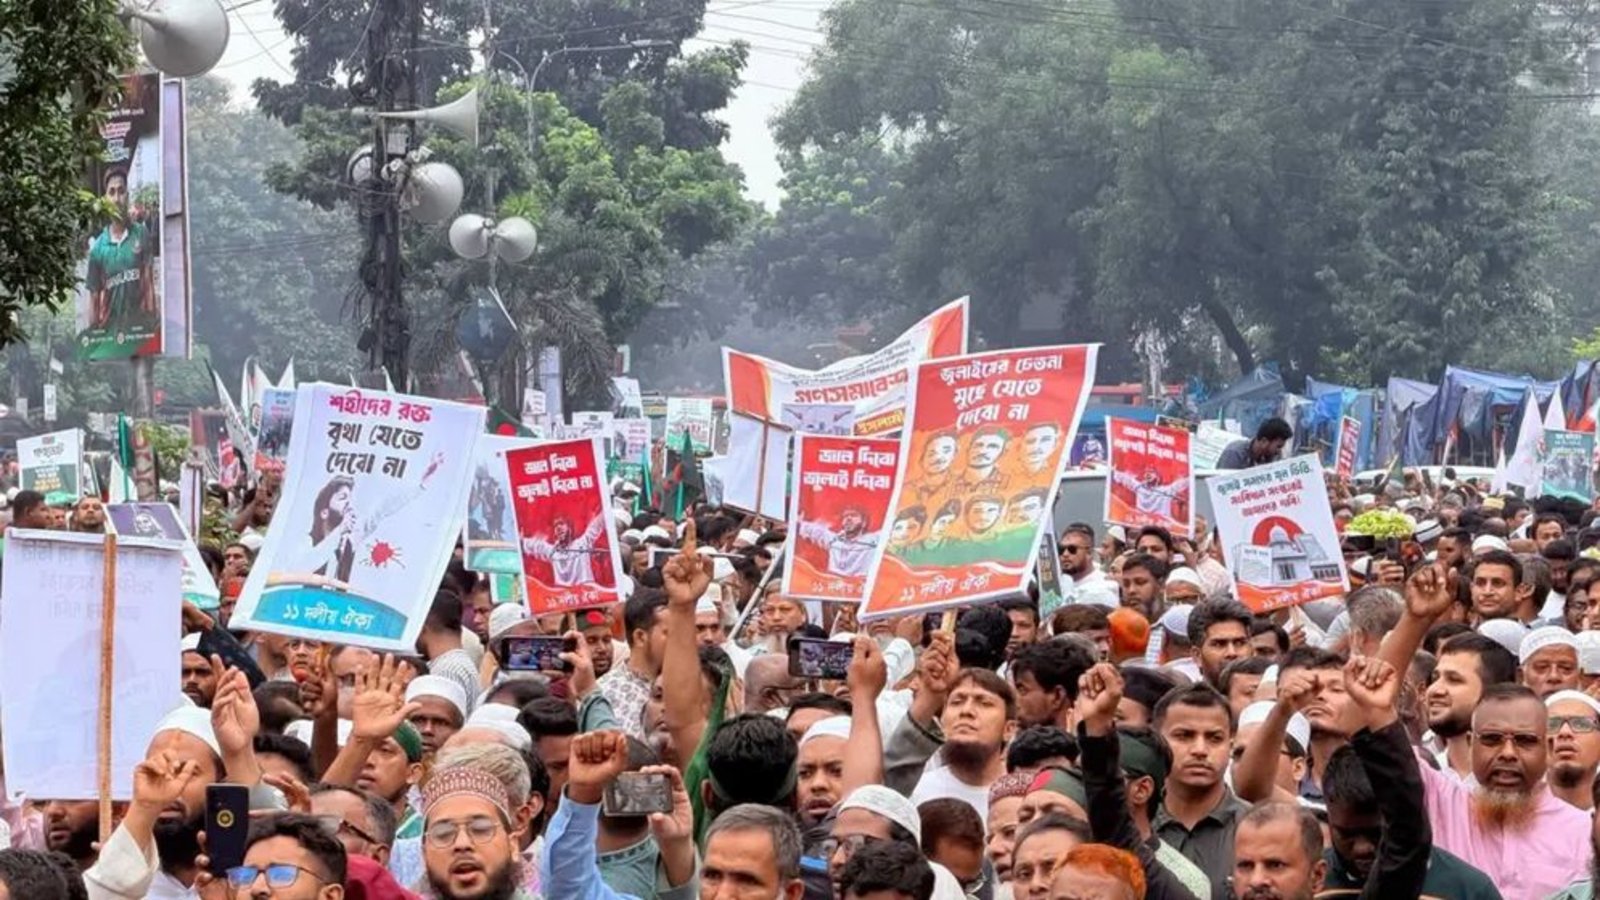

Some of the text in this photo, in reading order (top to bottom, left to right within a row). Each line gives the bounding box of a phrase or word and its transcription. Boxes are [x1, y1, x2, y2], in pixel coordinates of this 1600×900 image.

[1016, 355, 1063, 374] চেতনা
[329, 390, 432, 423] শহীদের রক্ত
[953, 378, 1043, 410] মুছে যেতে
[956, 404, 1029, 430] দেবো না
[328, 422, 424, 450] বৃথা যেতে
[326, 452, 407, 479] দেবো না
[579, 475, 594, 489] না
[283, 603, 300, 620] ১১
[341, 604, 375, 631] ঐক্য
